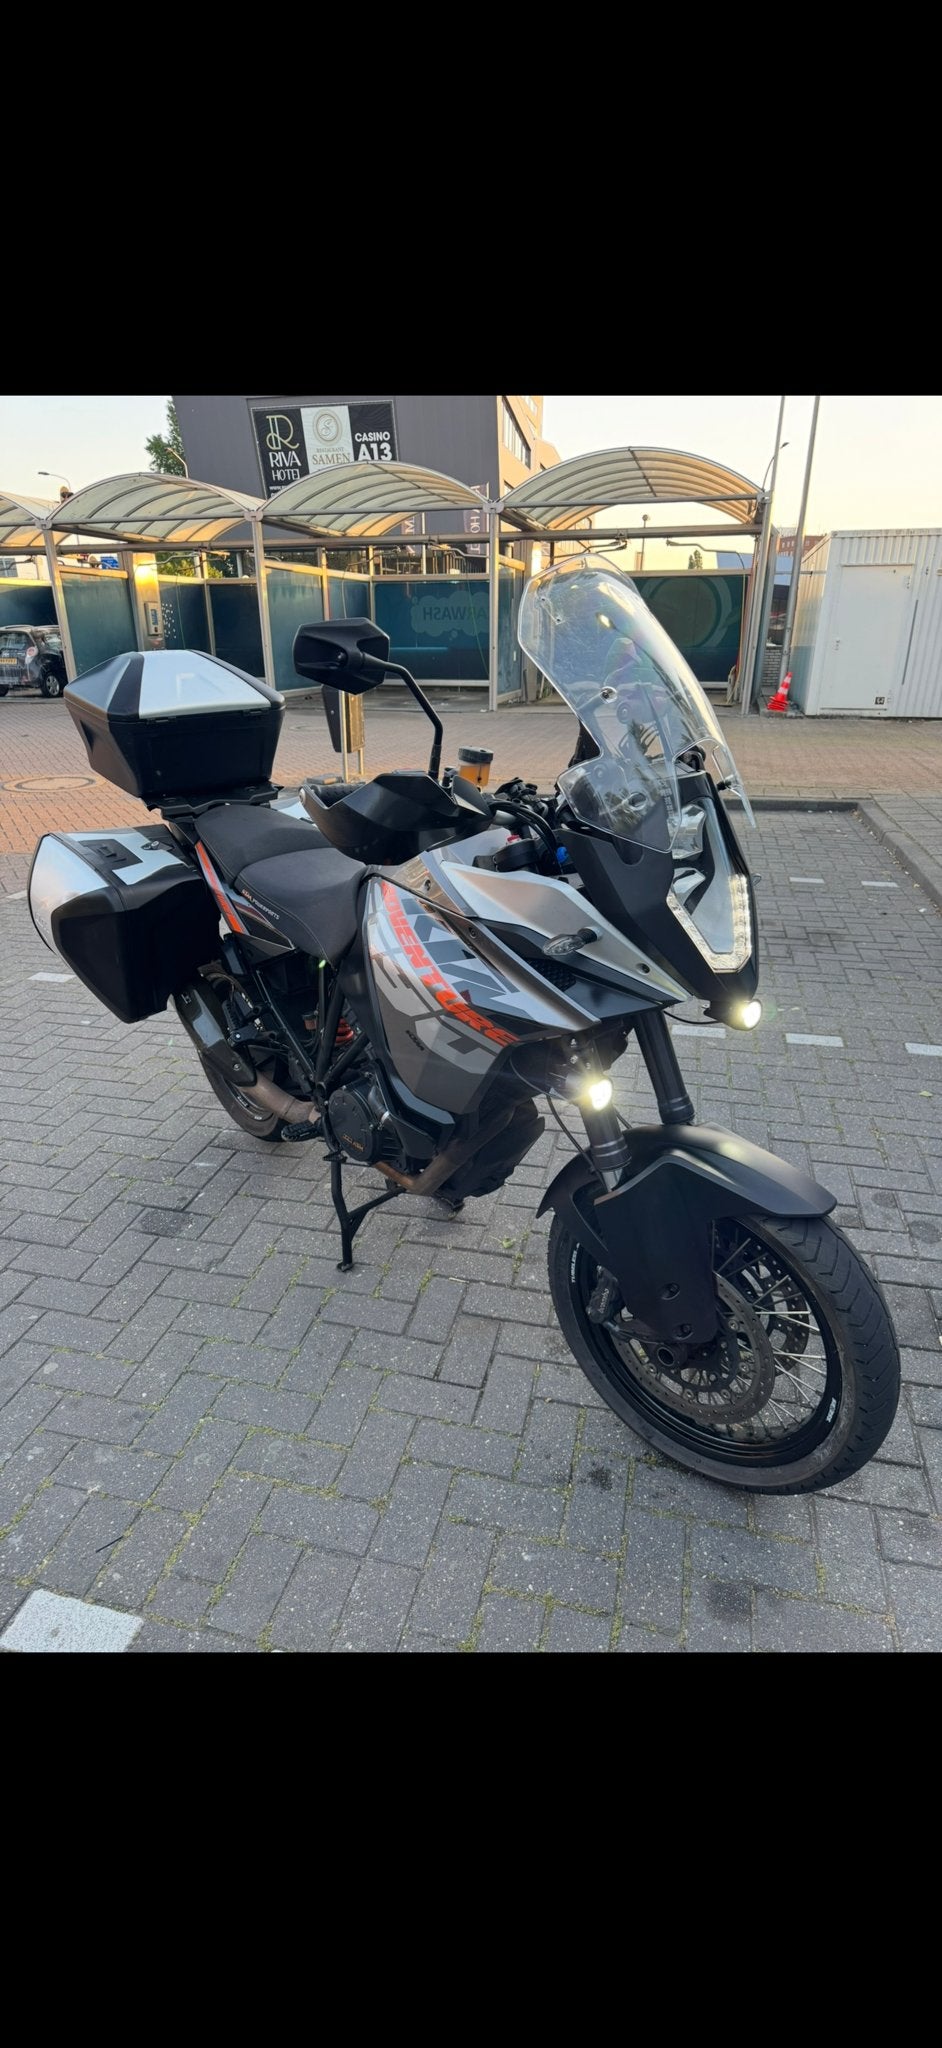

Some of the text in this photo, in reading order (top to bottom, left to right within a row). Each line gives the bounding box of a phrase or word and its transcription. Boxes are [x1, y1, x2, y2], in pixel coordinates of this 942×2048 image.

[354, 431, 391, 442] CASINO
[358, 442, 393, 461] A13
[269, 451, 302, 468] RIVA
[312, 453, 351, 465] SAMEN
